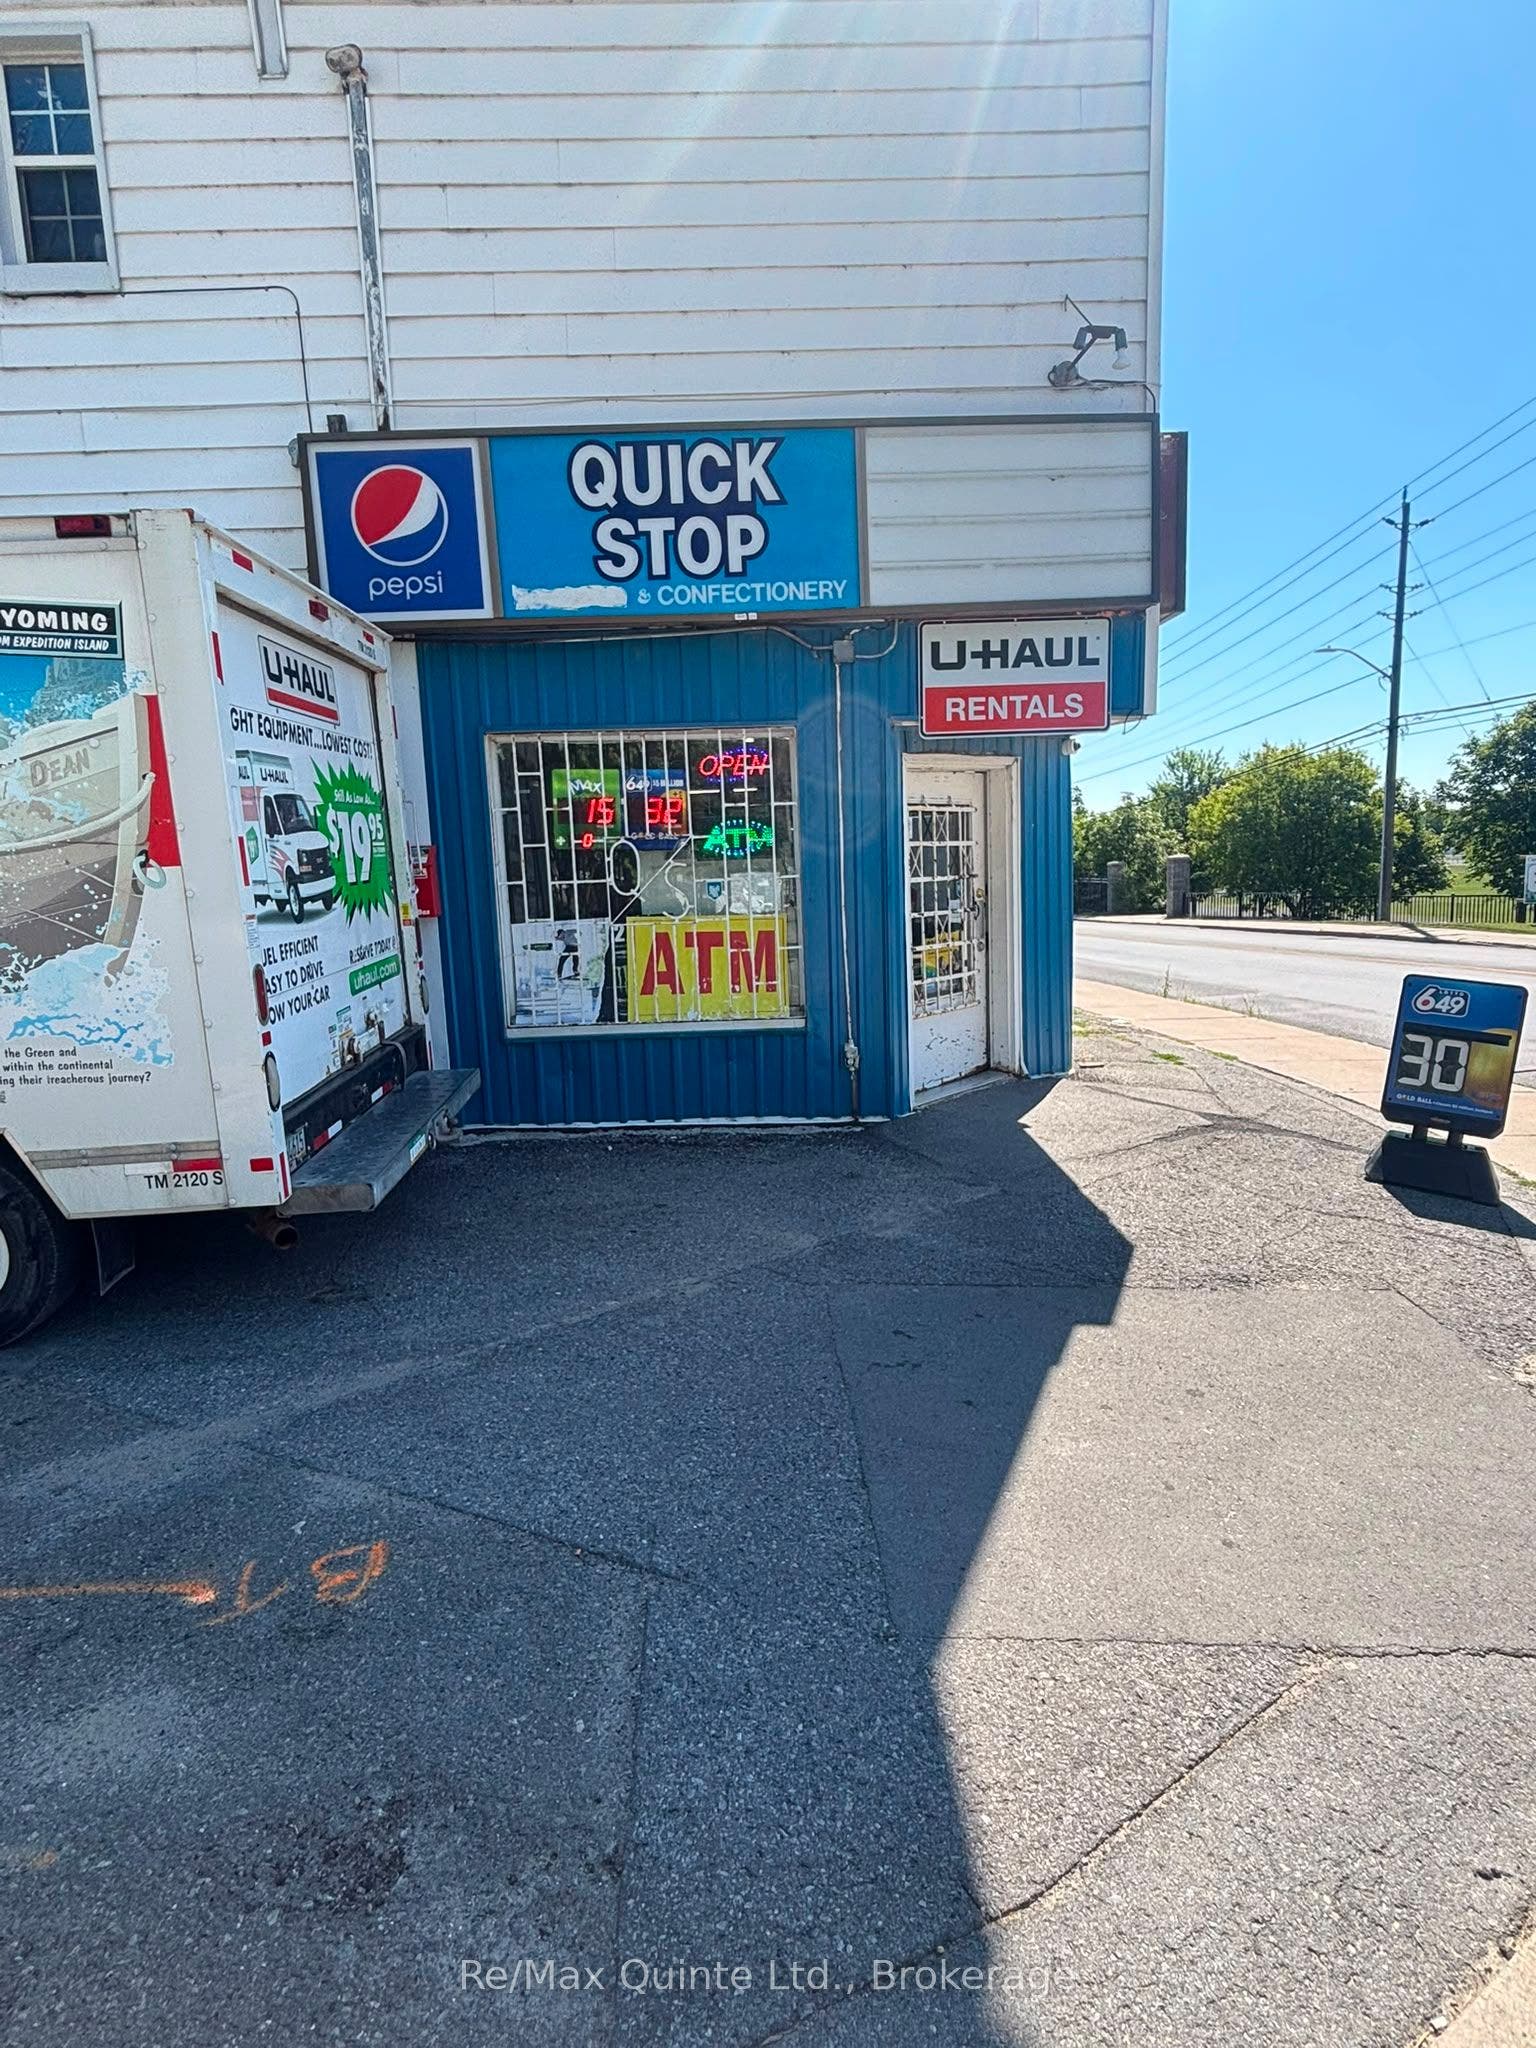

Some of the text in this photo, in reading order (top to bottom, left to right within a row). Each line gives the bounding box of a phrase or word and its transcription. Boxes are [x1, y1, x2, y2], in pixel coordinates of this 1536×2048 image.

[569, 439, 784, 511] QUICK
[594, 512, 768, 580] STOP
[368, 570, 444, 601] pepsi
[637, 580, 848, 606] & CONFECTIONERY
[13, 636, 71, 650] EXPEDITION
[74, 639, 109, 651] ISLAND
[945, 693, 1084, 722] RENTALS
[30, 748, 90, 788] DEAN
[699, 754, 769, 777] OPEN
[586, 797, 615, 825] 15
[647, 797, 683, 824] 32
[703, 827, 774, 850] ATM
[279, 935, 319, 962] EFFICIENT
[285, 969, 299, 988] TO
[300, 961, 324, 983] DRIVE
[354, 961, 398, 990] uhaul.com
[639, 930, 777, 996] ATM
[287, 991, 313, 1016] YOUR
[313, 985, 331, 1004] CAR
[1416, 987, 1466, 1014] 649
[3, 1059, 113, 1072] within the continental
[5, 1046, 77, 1058] the Green and
[1397, 1033, 1470, 1092] 30
[20, 1074, 42, 1085] their
[47, 1073, 105, 1085] treacherous
[108, 1071, 152, 1085] journey?
[144, 1171, 223, 1190] TM 2120 S
